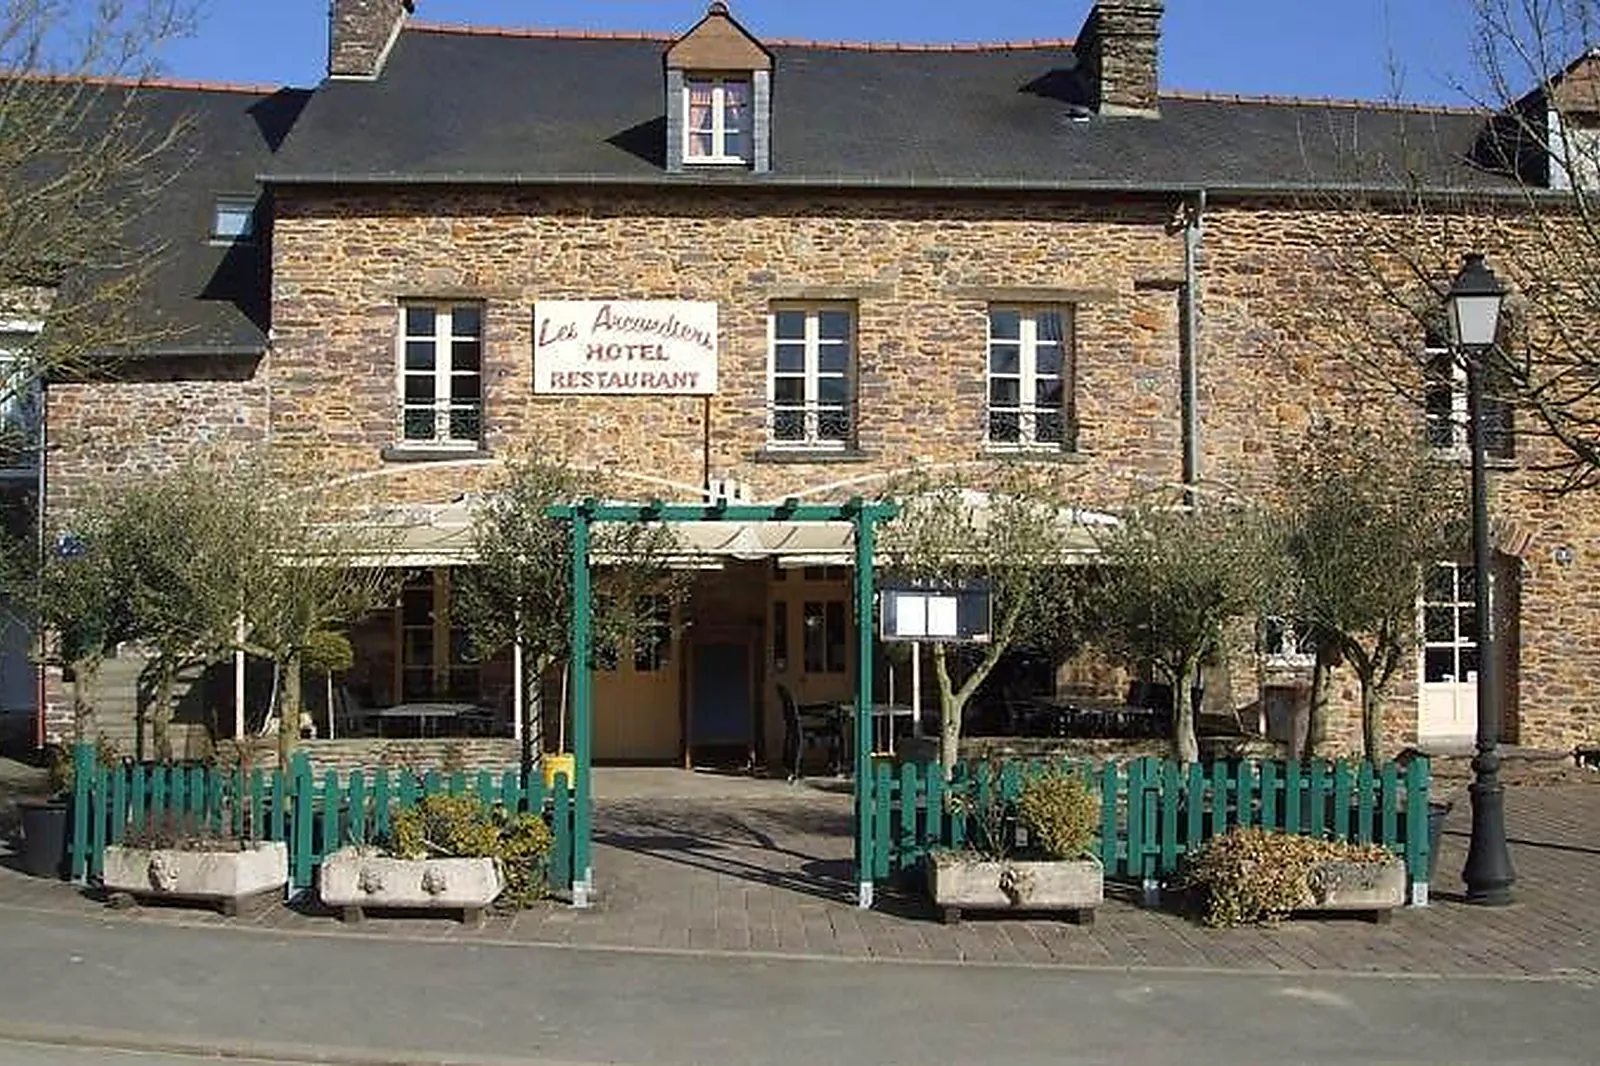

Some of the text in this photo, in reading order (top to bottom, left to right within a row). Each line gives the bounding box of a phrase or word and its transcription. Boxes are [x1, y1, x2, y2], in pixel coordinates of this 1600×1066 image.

[539, 317, 579, 347] Les
[586, 343, 670, 361] HOTEL
[550, 371, 701, 389] RESTAURANT
[911, 577, 967, 589] MENU
